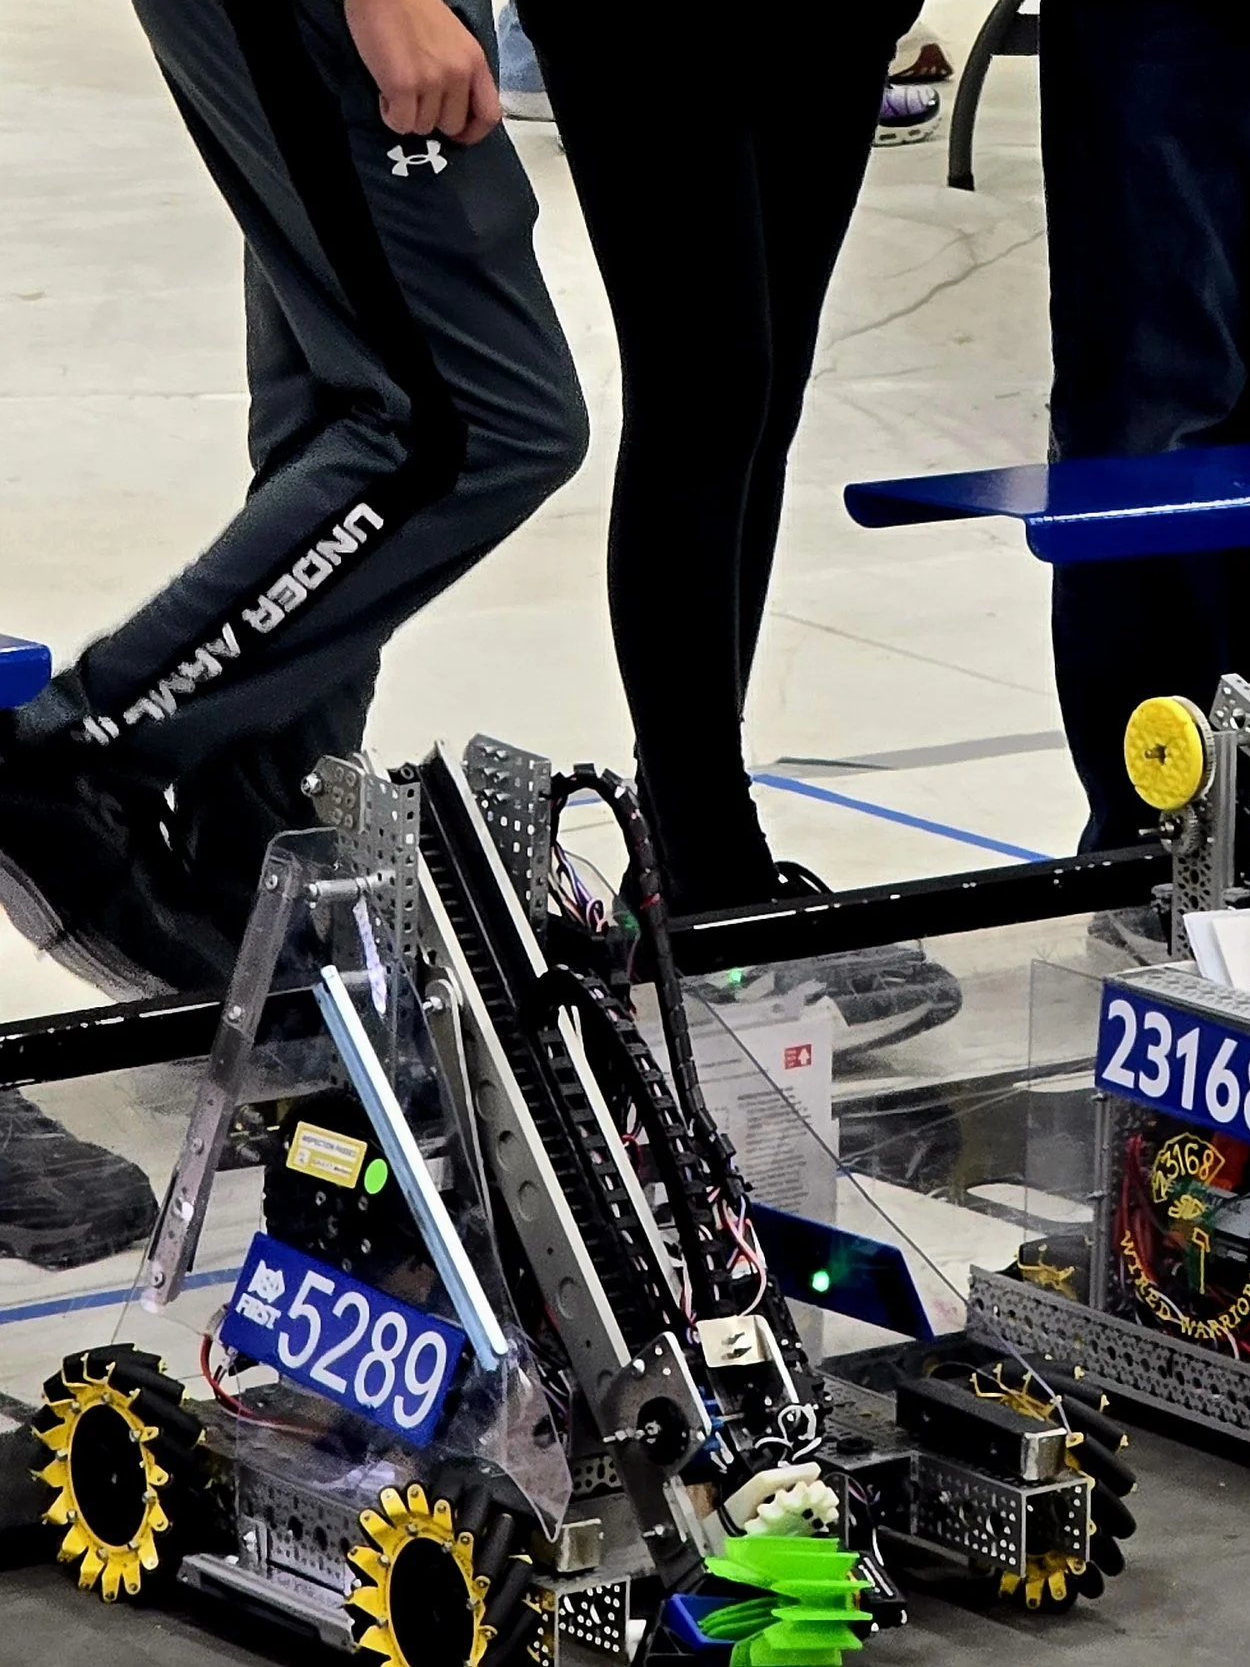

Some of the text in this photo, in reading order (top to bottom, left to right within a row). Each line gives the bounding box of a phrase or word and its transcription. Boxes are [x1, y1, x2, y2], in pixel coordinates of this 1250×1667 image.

[242, 502, 384, 634] UNDER
[1119, 1230, 1173, 1319] WIRED
[278, 1269, 448, 1429] 5289
